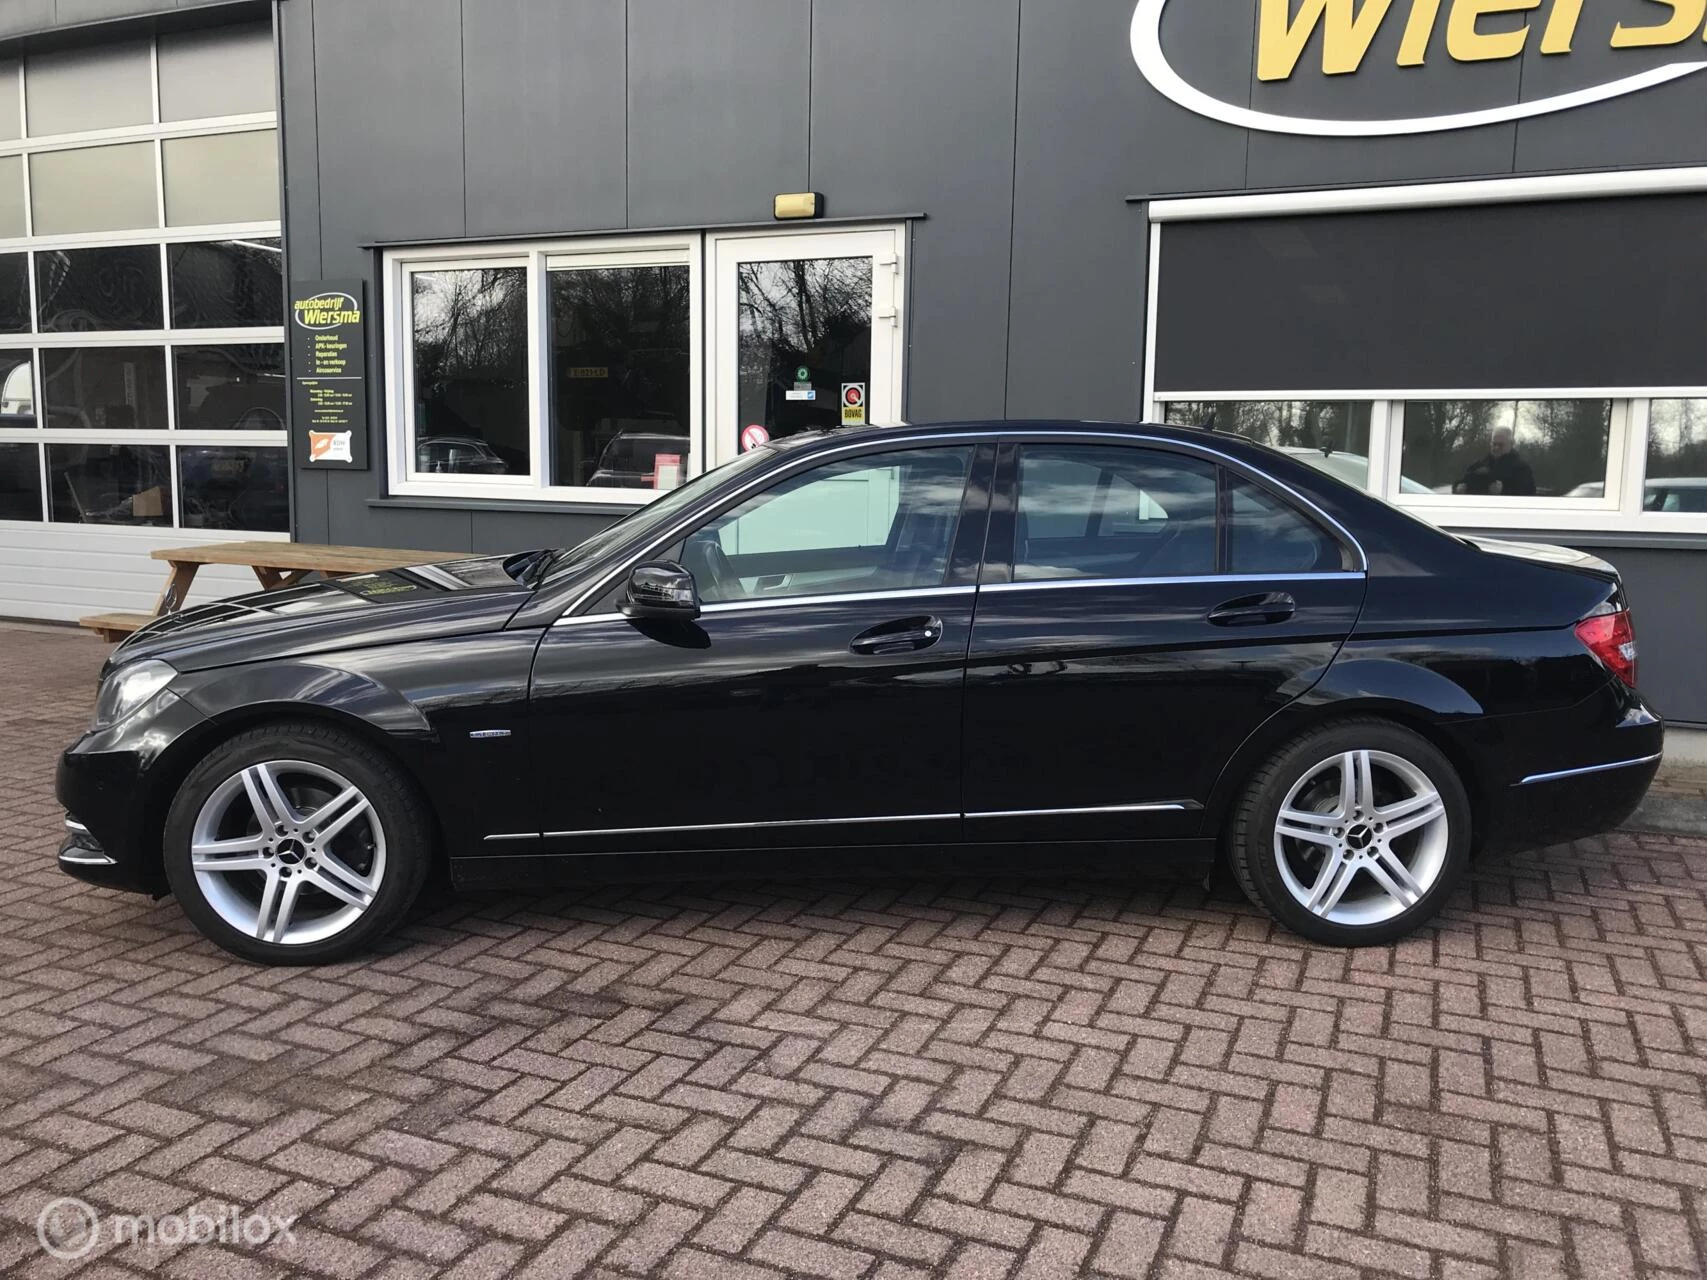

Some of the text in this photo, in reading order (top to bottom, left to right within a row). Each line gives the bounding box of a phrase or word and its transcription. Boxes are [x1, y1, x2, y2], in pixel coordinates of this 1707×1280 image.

[294, 297, 344, 310] autobedrijf
[304, 309, 360, 325] Wiersma
[844, 409, 862, 418] BOVAG
